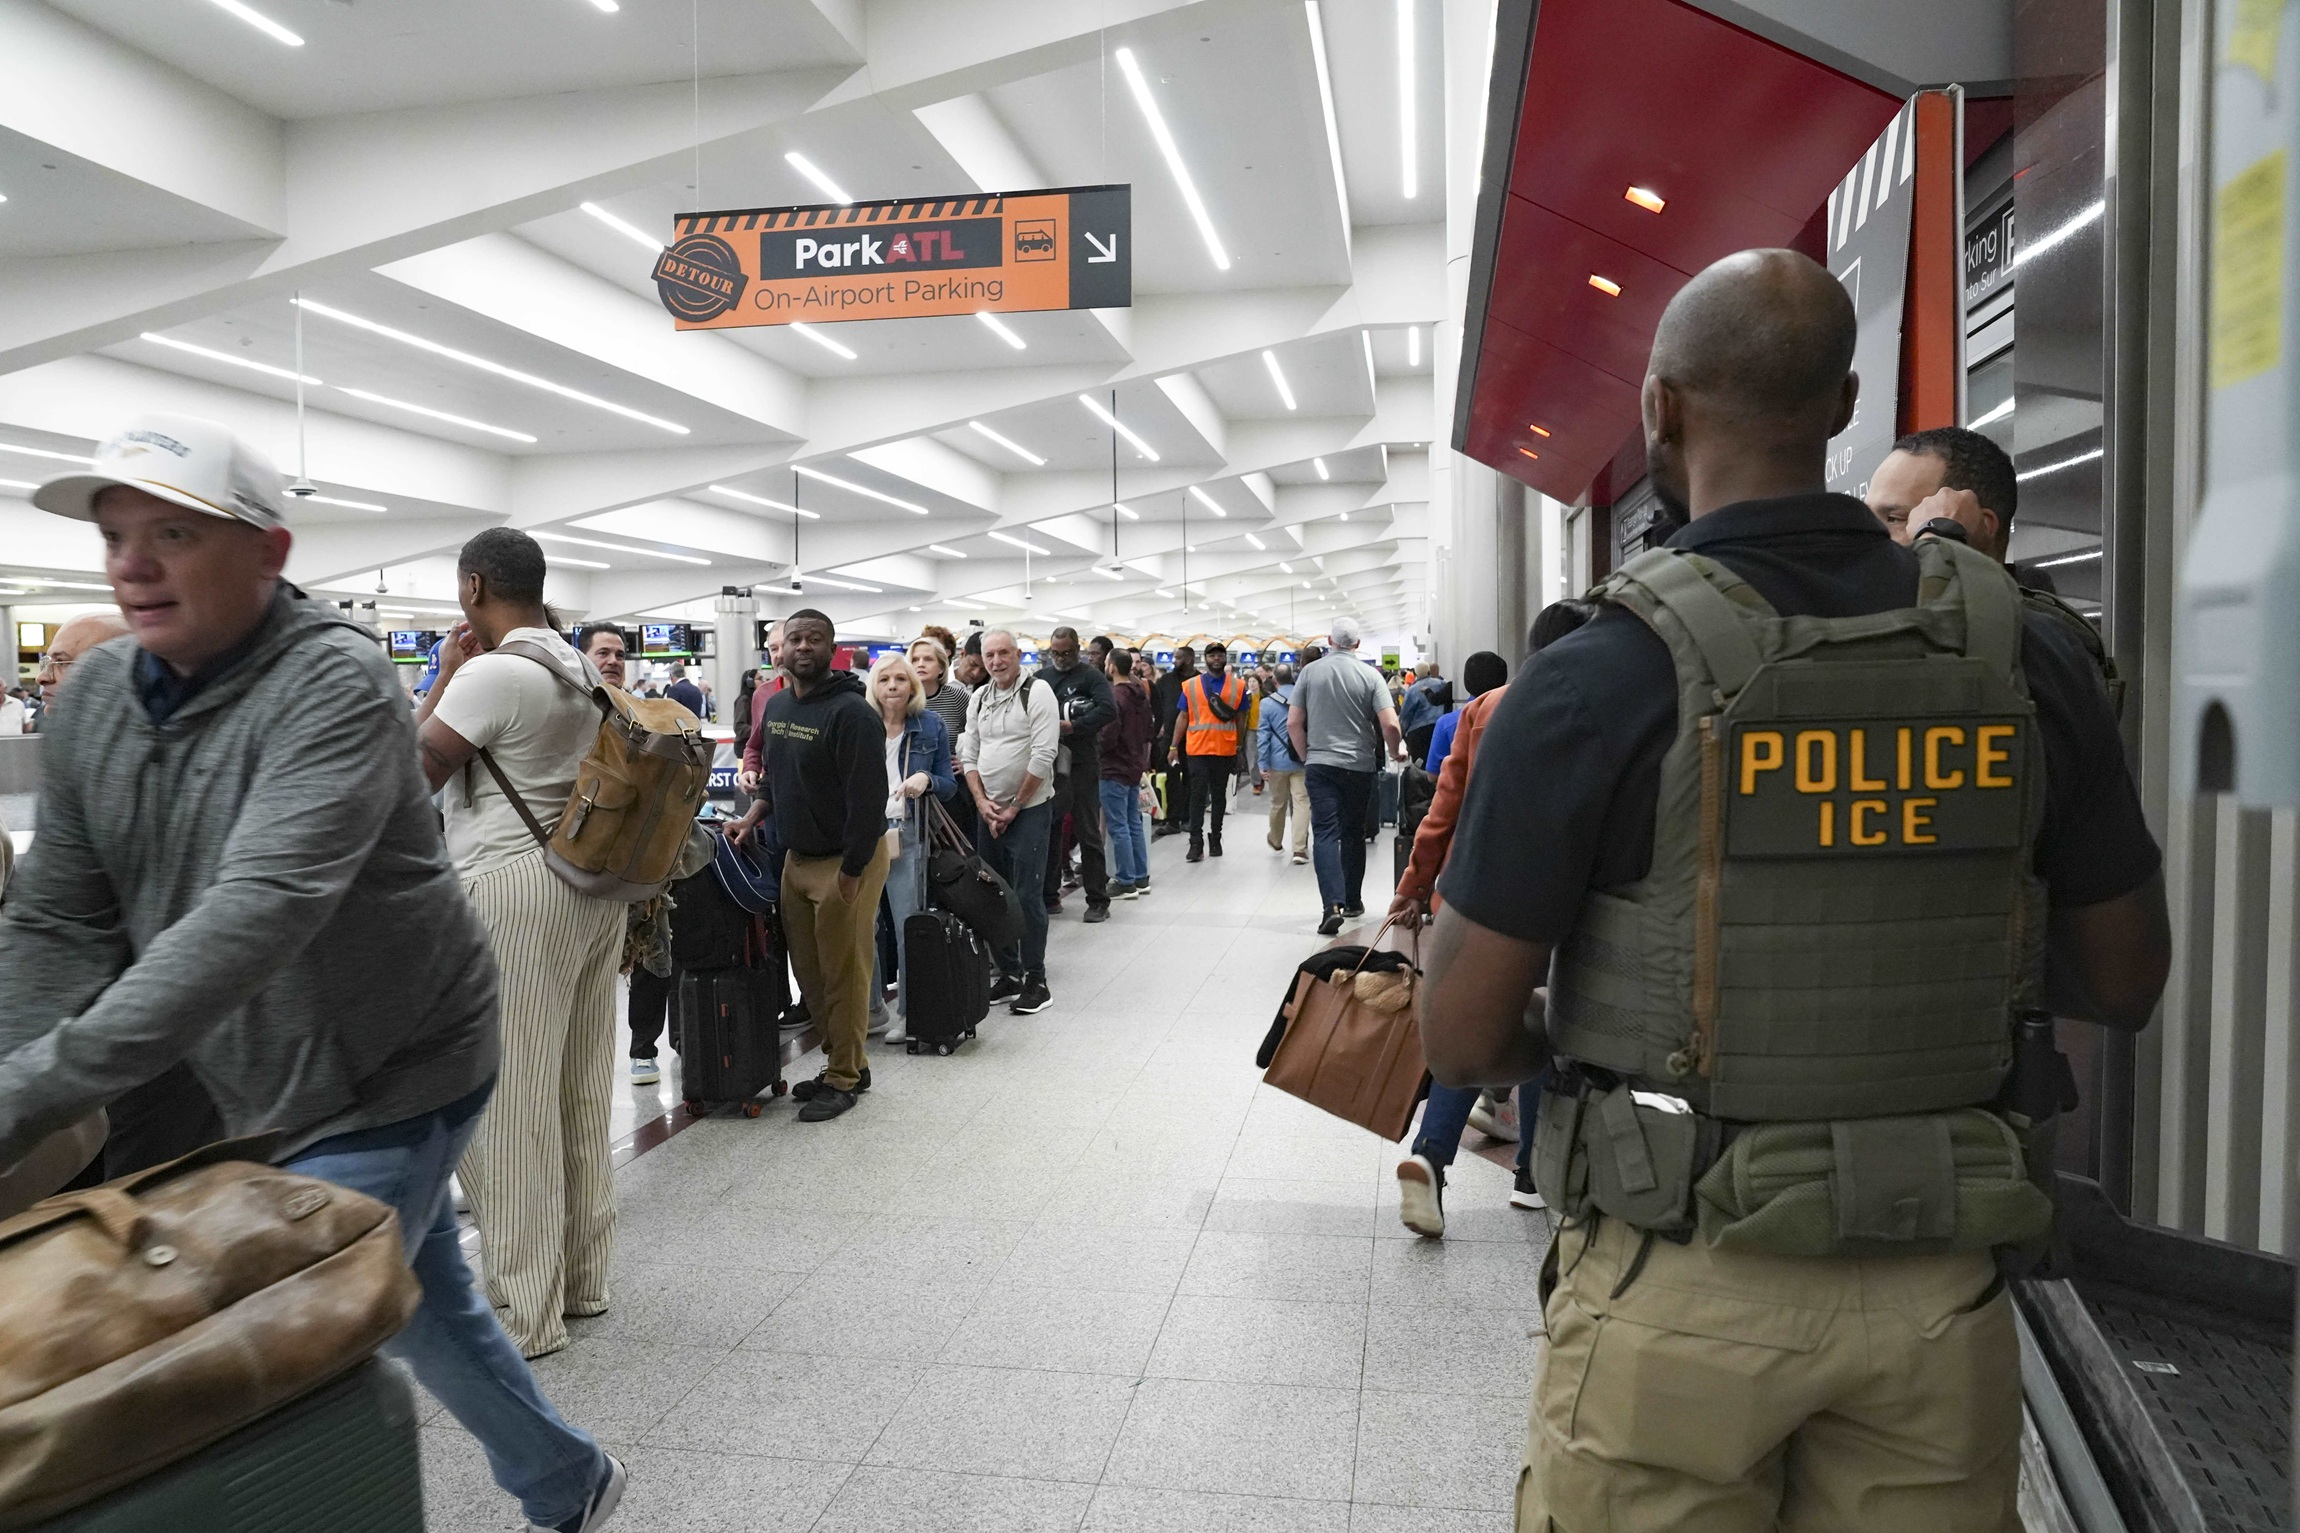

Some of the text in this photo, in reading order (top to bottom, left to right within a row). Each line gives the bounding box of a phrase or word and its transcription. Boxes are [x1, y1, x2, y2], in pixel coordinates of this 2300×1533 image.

[663, 258, 734, 295] DETOUR
[1980, 267, 1997, 292] Sur
[754, 276, 1004, 311] On-Airport Parking
[1839, 446, 1853, 476] UP
[789, 722, 820, 735] Research
[1739, 725, 2016, 796] POLICE
[706, 772, 732, 787] RST
[1818, 798, 1938, 847] ICE
